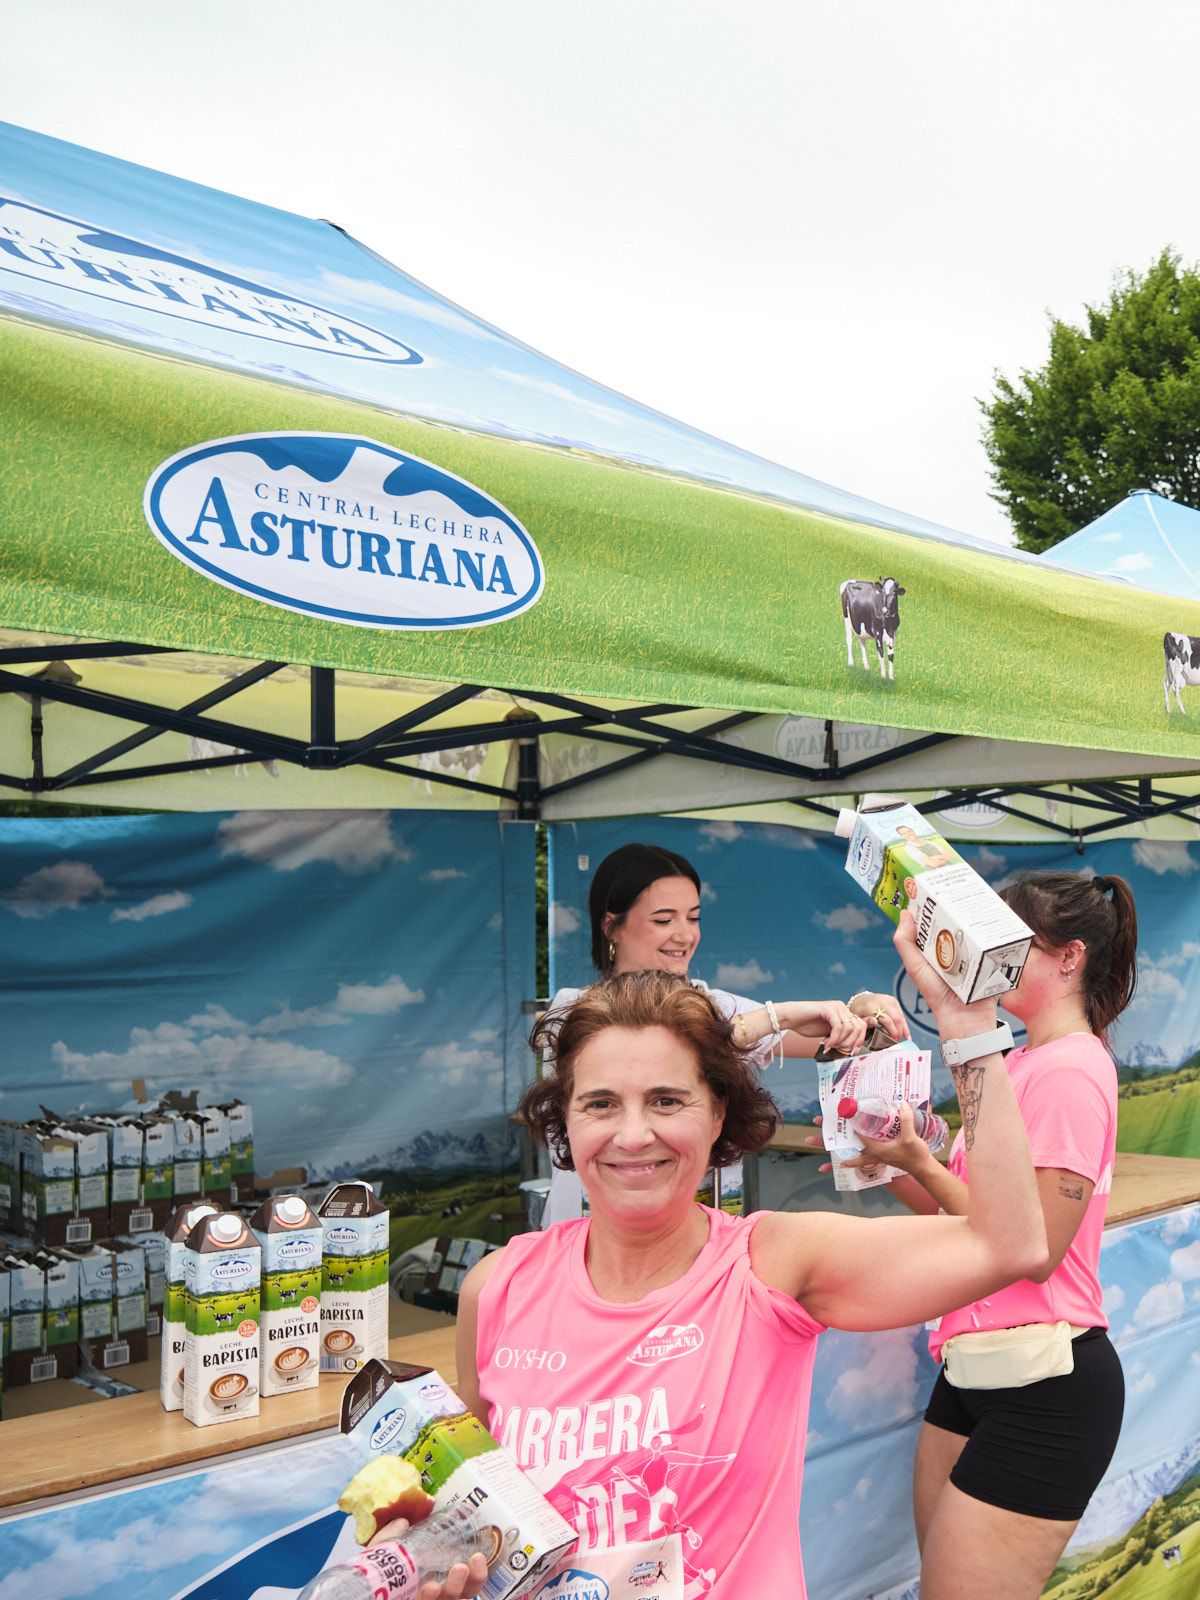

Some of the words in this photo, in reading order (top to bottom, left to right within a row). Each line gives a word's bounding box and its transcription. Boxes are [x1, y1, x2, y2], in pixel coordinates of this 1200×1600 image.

[254, 482, 380, 522] CENTRAL
[392, 510, 504, 545] LECHERA
[186, 476, 518, 596] ASTURIANA
[915, 897, 937, 953] BARISTA
[213, 1266, 250, 1277] ASTURIANA
[284, 1316, 305, 1325] LECHE
[320, 1309, 365, 1321] BARISTA
[268, 1321, 319, 1342] BARISTA
[203, 1346, 258, 1368] BARISTA
[219, 1340, 242, 1350] LECHE
[495, 1347, 567, 1373] OYSHO
[373, 1412, 405, 1449] ASTURIANA
[366, 1552, 399, 1592] ZERO
[375, 1548, 407, 1588] SODIO
